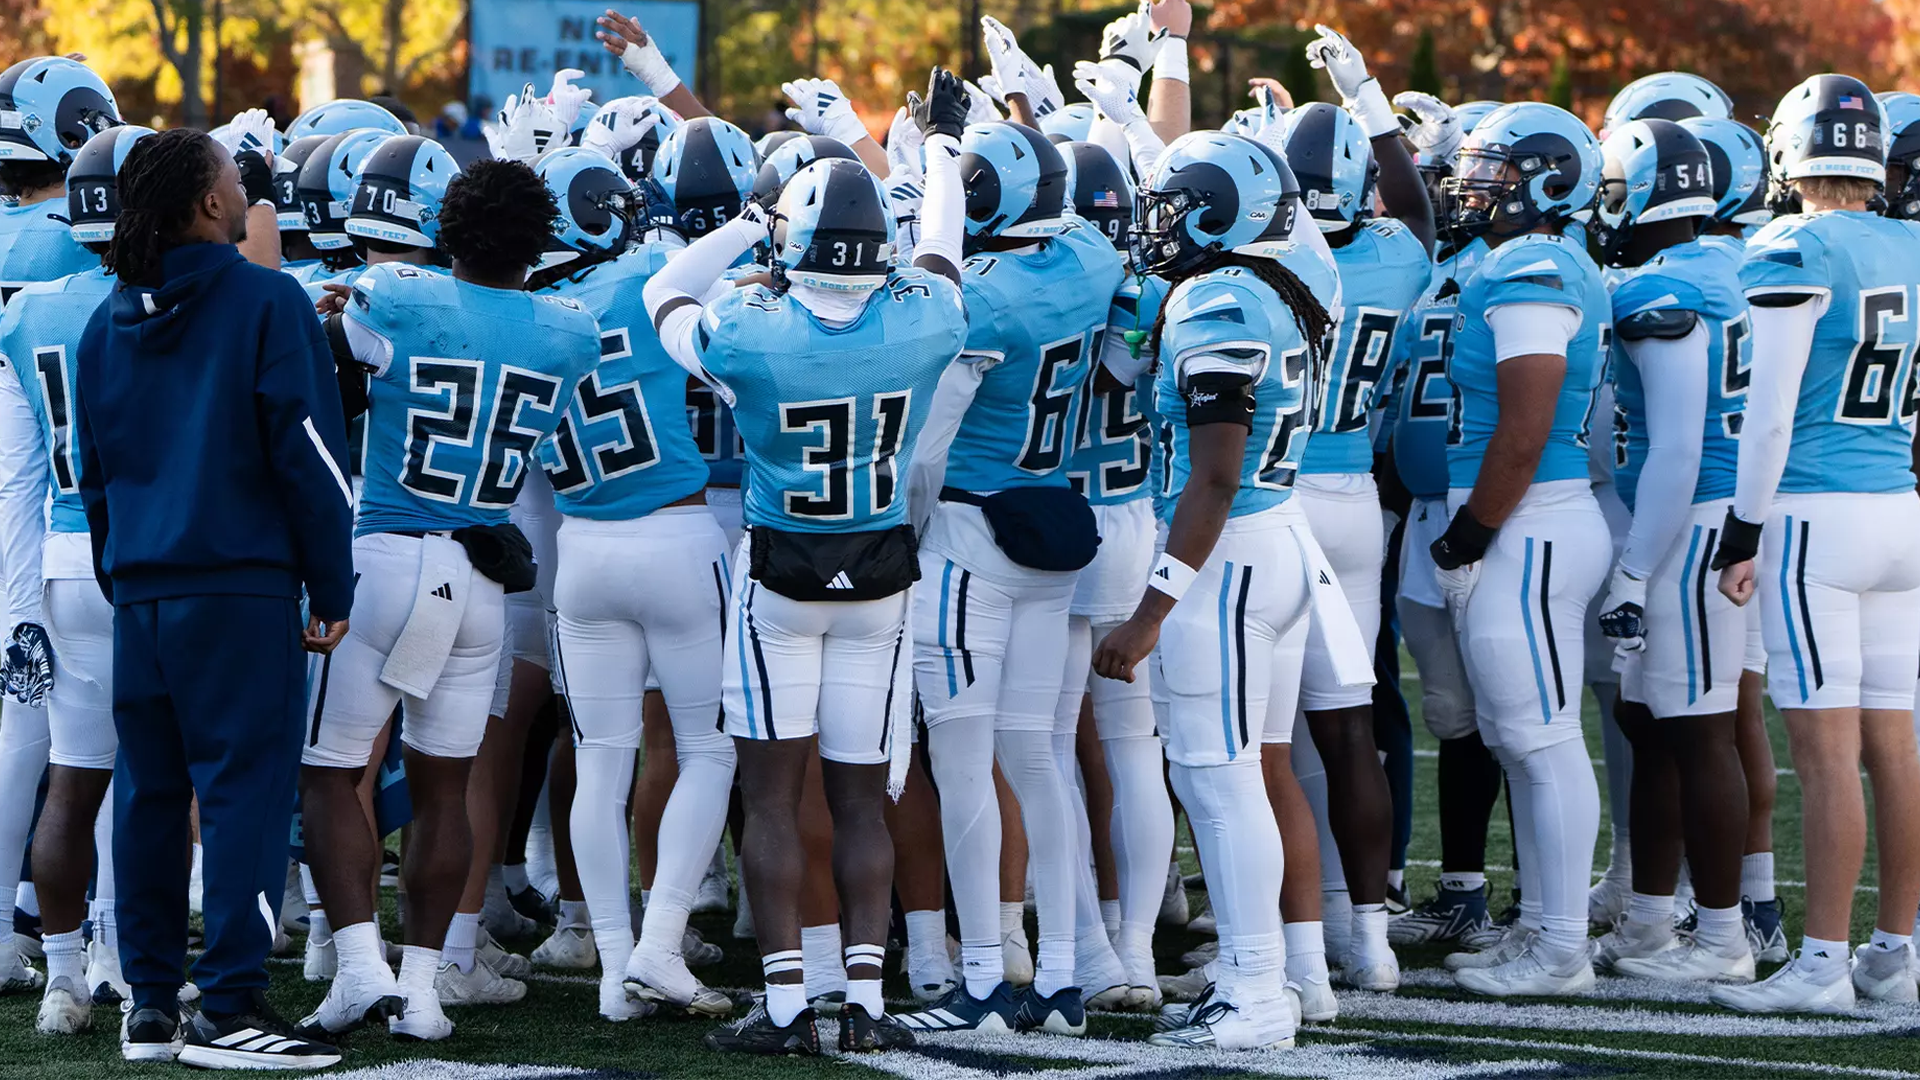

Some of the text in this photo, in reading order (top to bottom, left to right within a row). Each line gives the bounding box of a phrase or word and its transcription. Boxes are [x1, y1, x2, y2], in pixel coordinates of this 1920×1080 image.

[494, 48, 677, 75] RE-ENT
[1833, 122, 1867, 148] 66
[1676, 164, 1705, 189] 54
[1825, 164, 1853, 172] MORE
[1856, 166, 1876, 174] FEET
[80, 186, 107, 213] 13
[366, 185, 396, 214] 70
[1677, 204, 1700, 213] MORE
[357, 226, 379, 236] MORE
[382, 230, 408, 240] FEET
[832, 242, 862, 267] 31
[820, 281, 849, 290] MORE
[851, 283, 876, 291] FEET
[1253, 343, 1316, 492] 2
[397, 356, 564, 510] 26
[778, 388, 912, 520] 31
